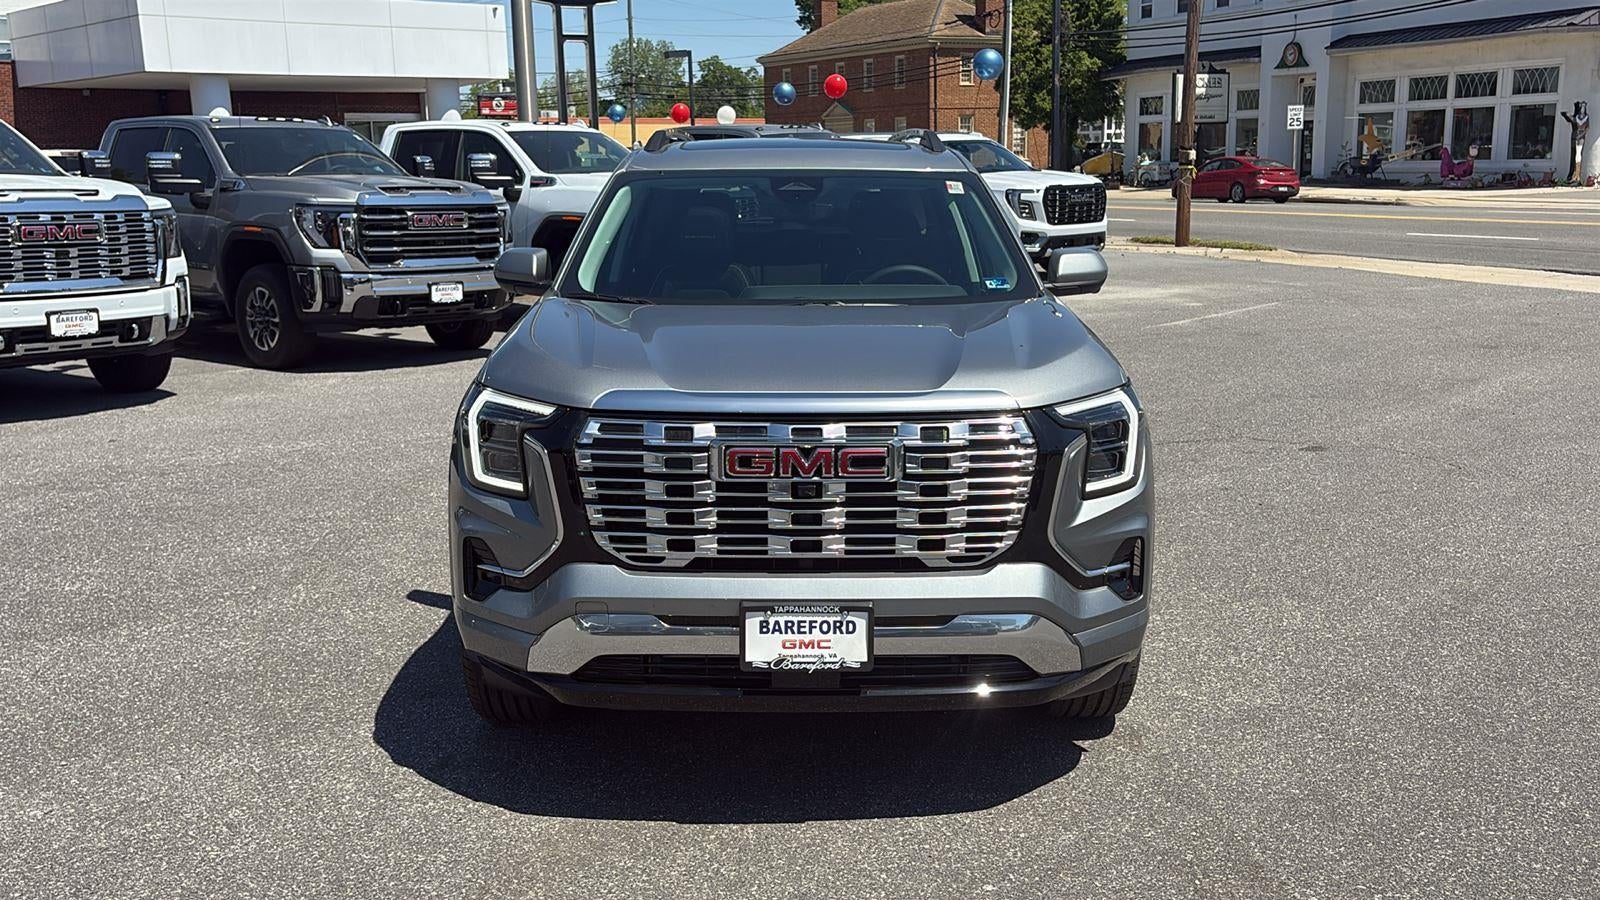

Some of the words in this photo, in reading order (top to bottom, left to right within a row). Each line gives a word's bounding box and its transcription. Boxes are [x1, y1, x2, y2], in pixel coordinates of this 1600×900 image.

[1289, 117, 1302, 127] 25
[414, 214, 465, 227] GMC
[21, 224, 99, 241] GMC
[55, 315, 94, 324] BAREFORD
[726, 447, 888, 477] GMC
[759, 620, 857, 635] BAREFORD
[781, 639, 832, 650] GMC
[770, 657, 845, 674] Bareford
